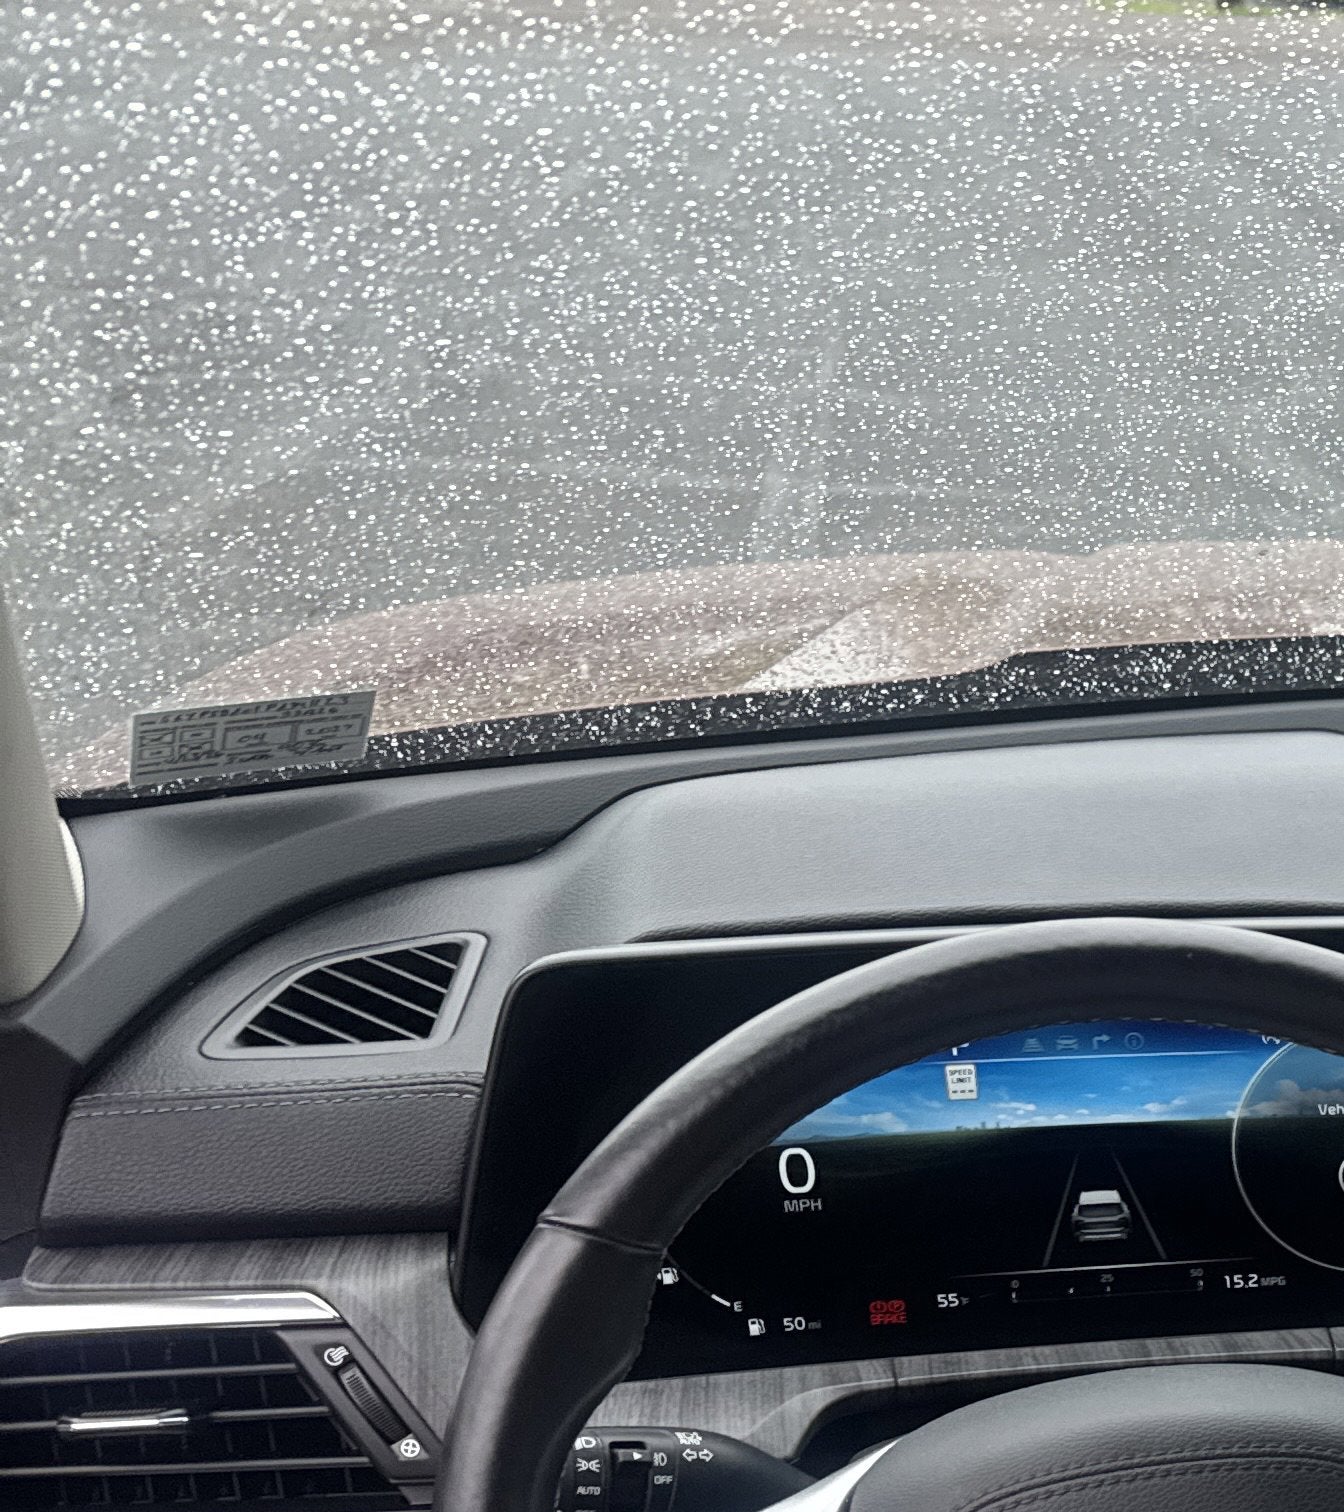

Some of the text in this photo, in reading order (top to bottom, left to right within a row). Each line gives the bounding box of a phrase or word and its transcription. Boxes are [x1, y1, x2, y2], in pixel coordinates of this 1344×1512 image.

[949, 1068, 974, 1076] SPEED
[778, 1147, 816, 1194] 0
[783, 1198, 822, 1213] MPH
[1224, 1273, 1259, 1289] 15.2
[733, 1300, 743, 1312] E
[937, 1293, 960, 1308] 55
[783, 1316, 822, 1332] 50 mi
[654, 1475, 673, 1485] OFF
[576, 1486, 601, 1496] AUTO
